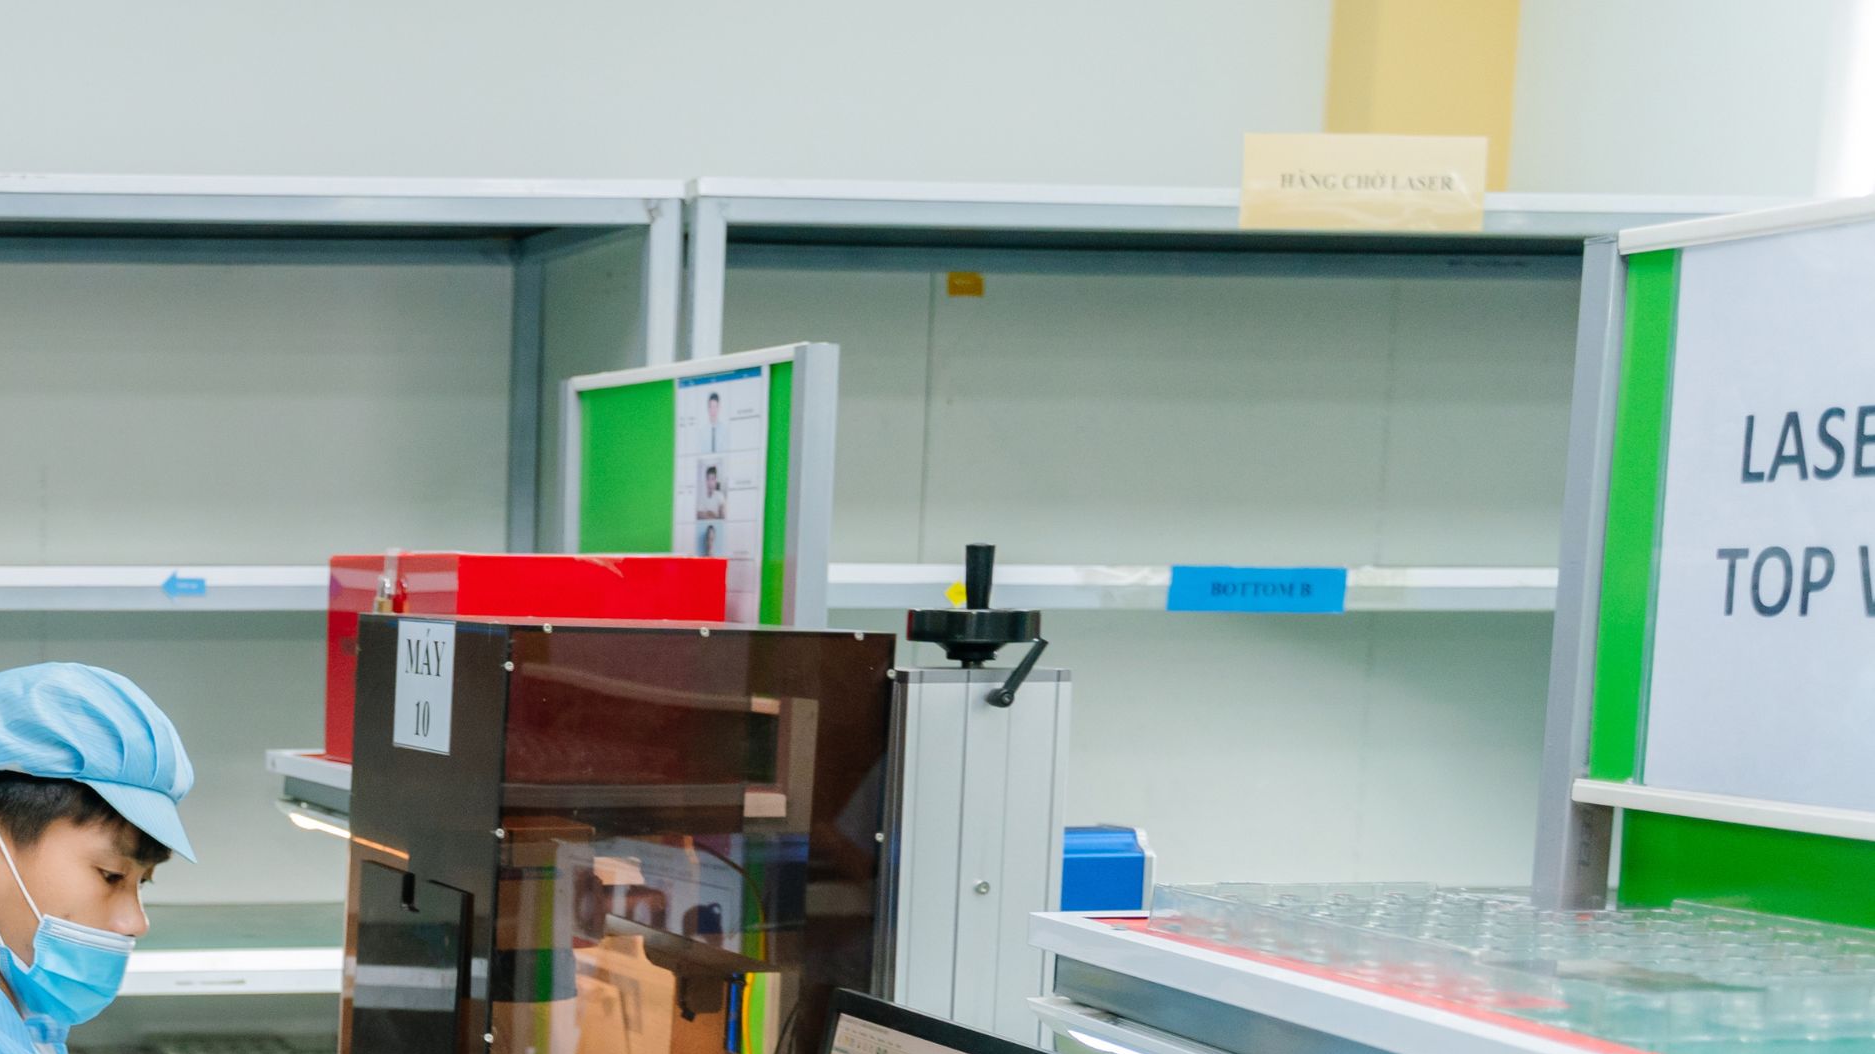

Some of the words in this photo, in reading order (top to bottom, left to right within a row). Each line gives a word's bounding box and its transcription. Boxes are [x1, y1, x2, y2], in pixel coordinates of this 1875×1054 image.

[1280, 169, 1336, 190] HÀNG
[1391, 174, 1454, 191] LASER
[1741, 405, 1875, 484] LASE
[1211, 582, 1294, 598] BOTTOM
[1300, 582, 1313, 598] B
[1716, 546, 1836, 617] TOP
[405, 628, 446, 677] MÁY
[413, 701, 430, 737] 10
